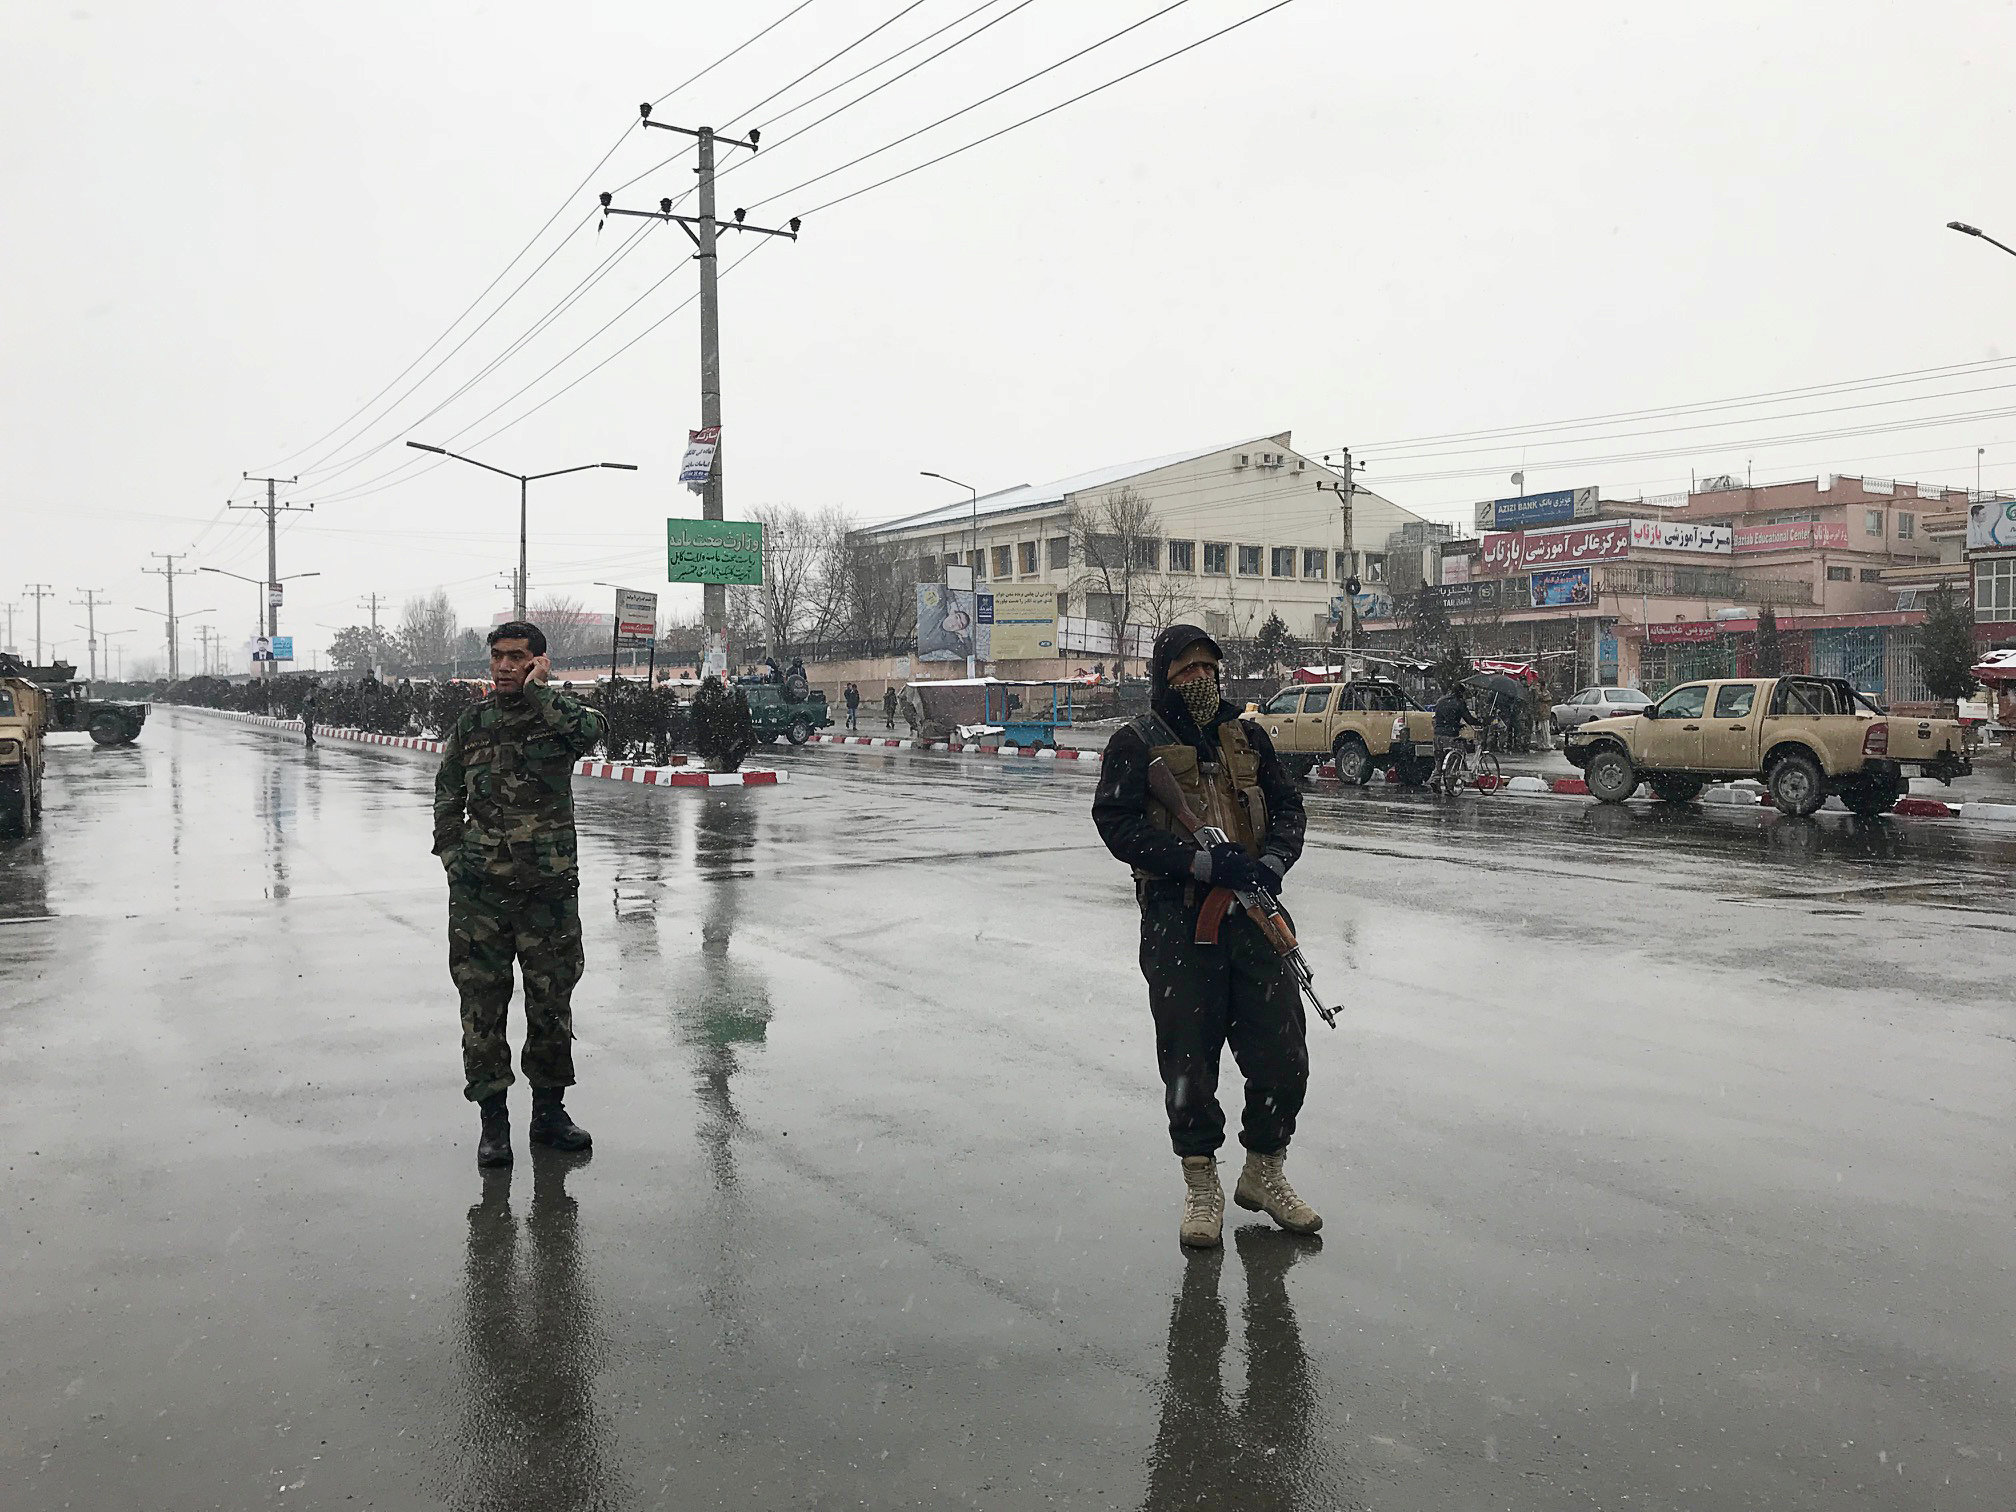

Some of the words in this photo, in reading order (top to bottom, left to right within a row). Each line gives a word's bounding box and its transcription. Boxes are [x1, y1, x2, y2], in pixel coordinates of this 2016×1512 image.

[1498, 503, 1516, 514] AZIZI
[1518, 501, 1537, 511] BANK
[692, 534, 723, 548] صحت
[1600, 532, 1628, 555] مرکز
[1633, 523, 1662, 545] بازتاب
[1664, 527, 1699, 547] آموزشی
[1698, 530, 1730, 549] مرکز
[1754, 530, 1789, 544] Educational
[1789, 528, 1810, 541] Center
[1484, 538, 1520, 568] بازتاب
[1525, 534, 1572, 561] آموزشی
[1572, 533, 1600, 557] عالی
[670, 550, 686, 565] کابل
